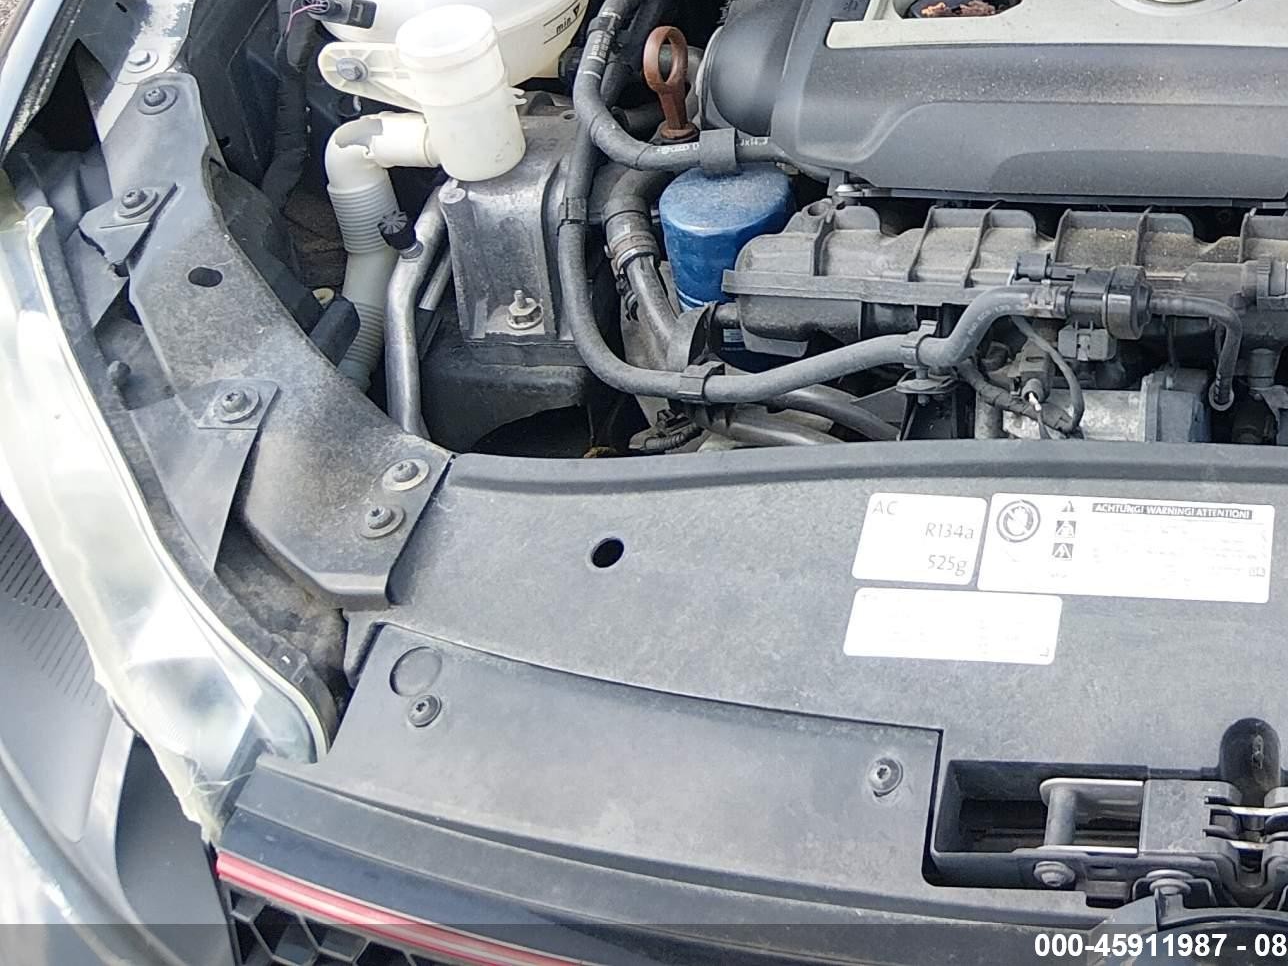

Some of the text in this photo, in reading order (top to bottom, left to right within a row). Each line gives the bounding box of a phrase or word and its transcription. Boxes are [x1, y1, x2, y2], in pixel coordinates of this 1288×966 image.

[555, 17, 572, 35] min
[872, 500, 899, 515] AC
[1095, 503, 1145, 514] ACHTUNG!
[1146, 505, 1195, 517] WARNING!
[925, 522, 975, 539] R134a
[928, 554, 968, 576] 525g
